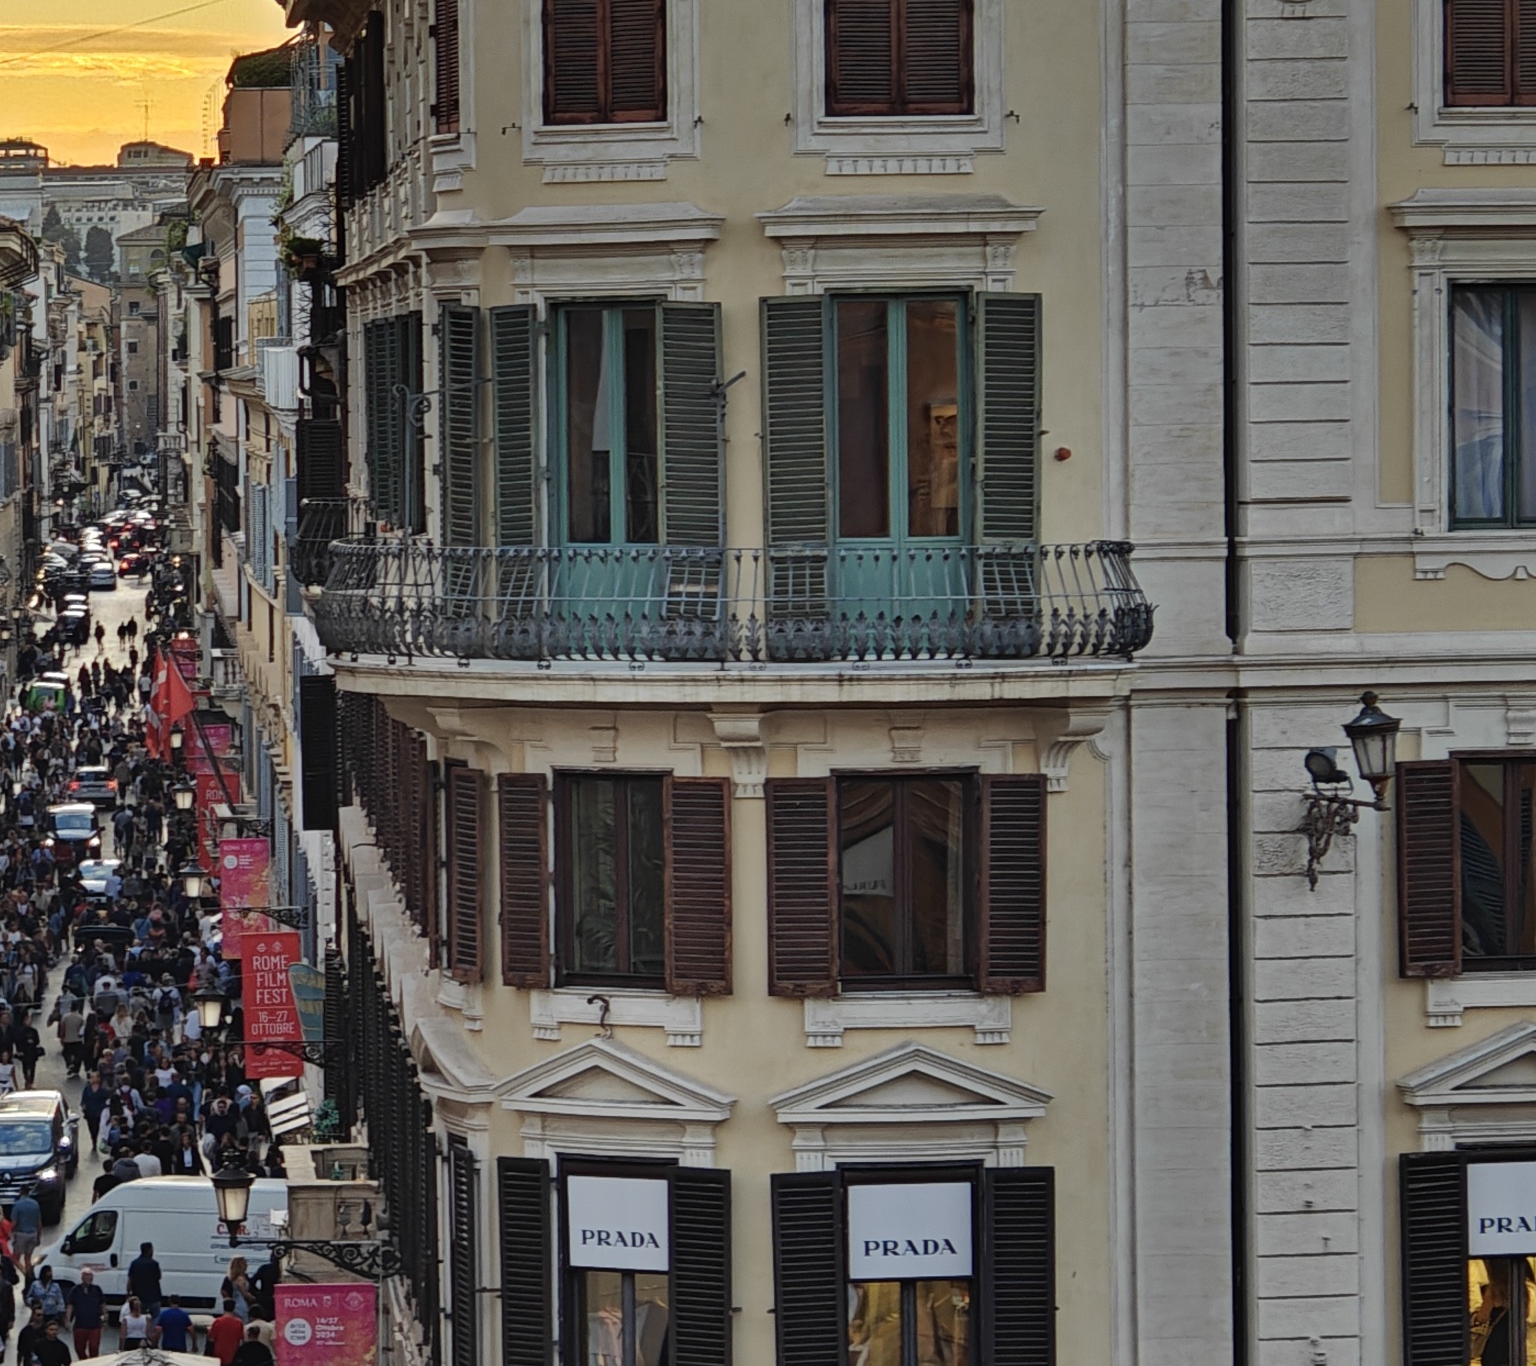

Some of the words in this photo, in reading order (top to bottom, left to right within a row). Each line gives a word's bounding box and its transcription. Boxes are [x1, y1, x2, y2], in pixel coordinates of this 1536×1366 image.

[252, 955, 289, 971] ROME
[256, 972, 287, 987] FILM
[256, 988, 289, 1004] FEST
[251, 1022, 296, 1035] OTTOBRE
[1479, 1216, 1536, 1234] PRA
[581, 1229, 661, 1249] PRADA
[863, 1238, 957, 1258] PRADA
[284, 1297, 318, 1308] ROMA
